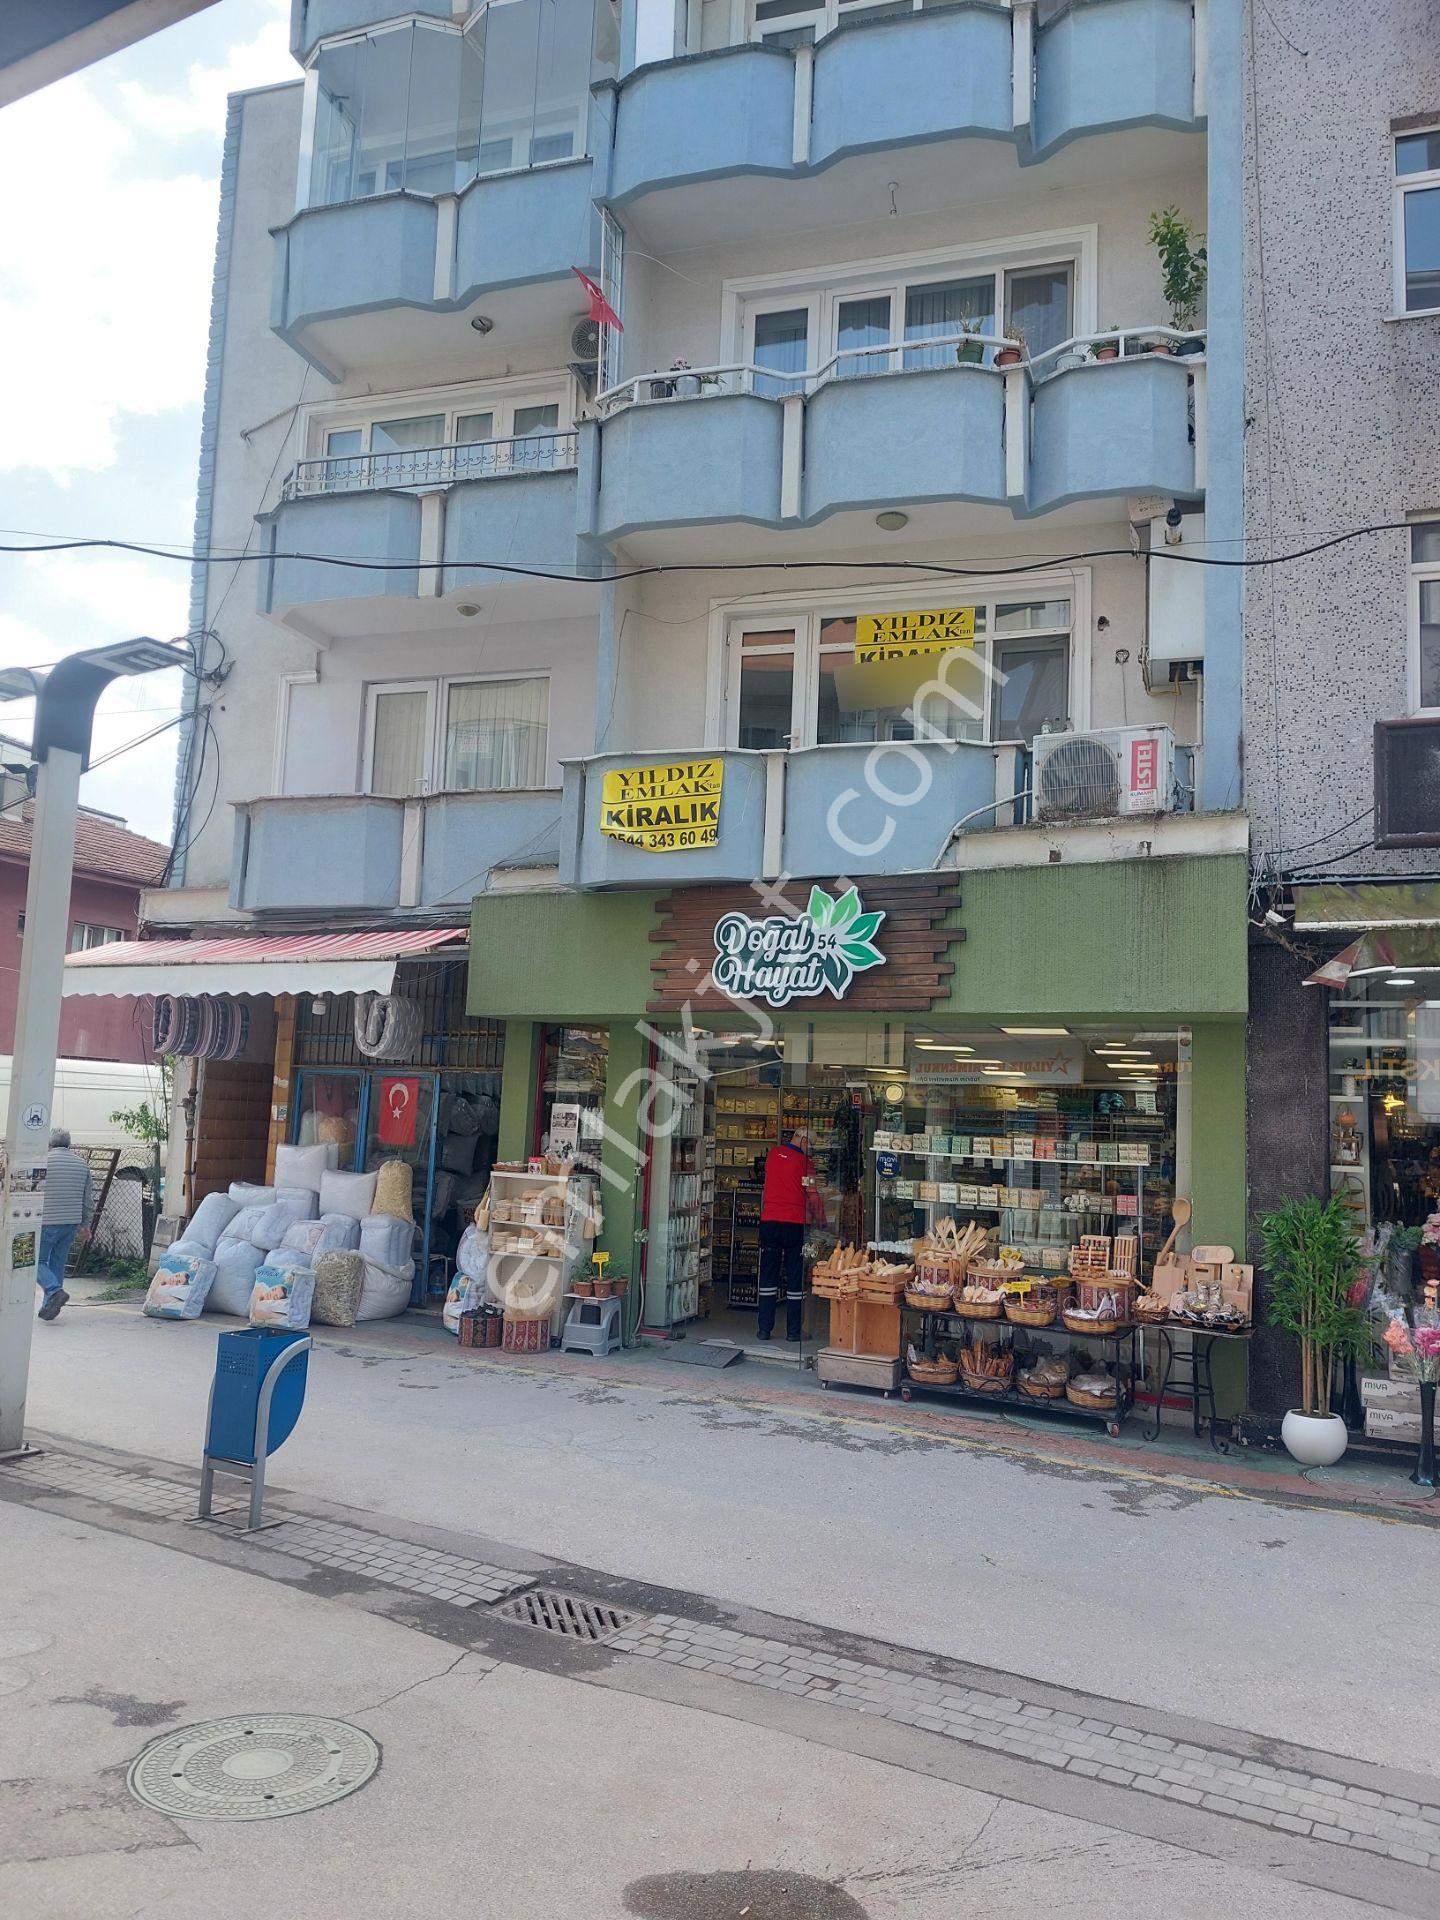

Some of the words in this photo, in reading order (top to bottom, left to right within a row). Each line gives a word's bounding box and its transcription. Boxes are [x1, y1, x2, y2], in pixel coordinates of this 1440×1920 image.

[872, 611, 965, 631] YILDIZ
[618, 764, 714, 786] YILDIZ
[607, 801, 718, 828] KİRALIK
[650, 833, 675, 848] 343
[680, 830, 696, 846] 60
[701, 828, 716, 843] 49
[717, 917, 811, 961] Doğal
[817, 933, 838, 950] 54
[718, 956, 821, 996] Hayat
